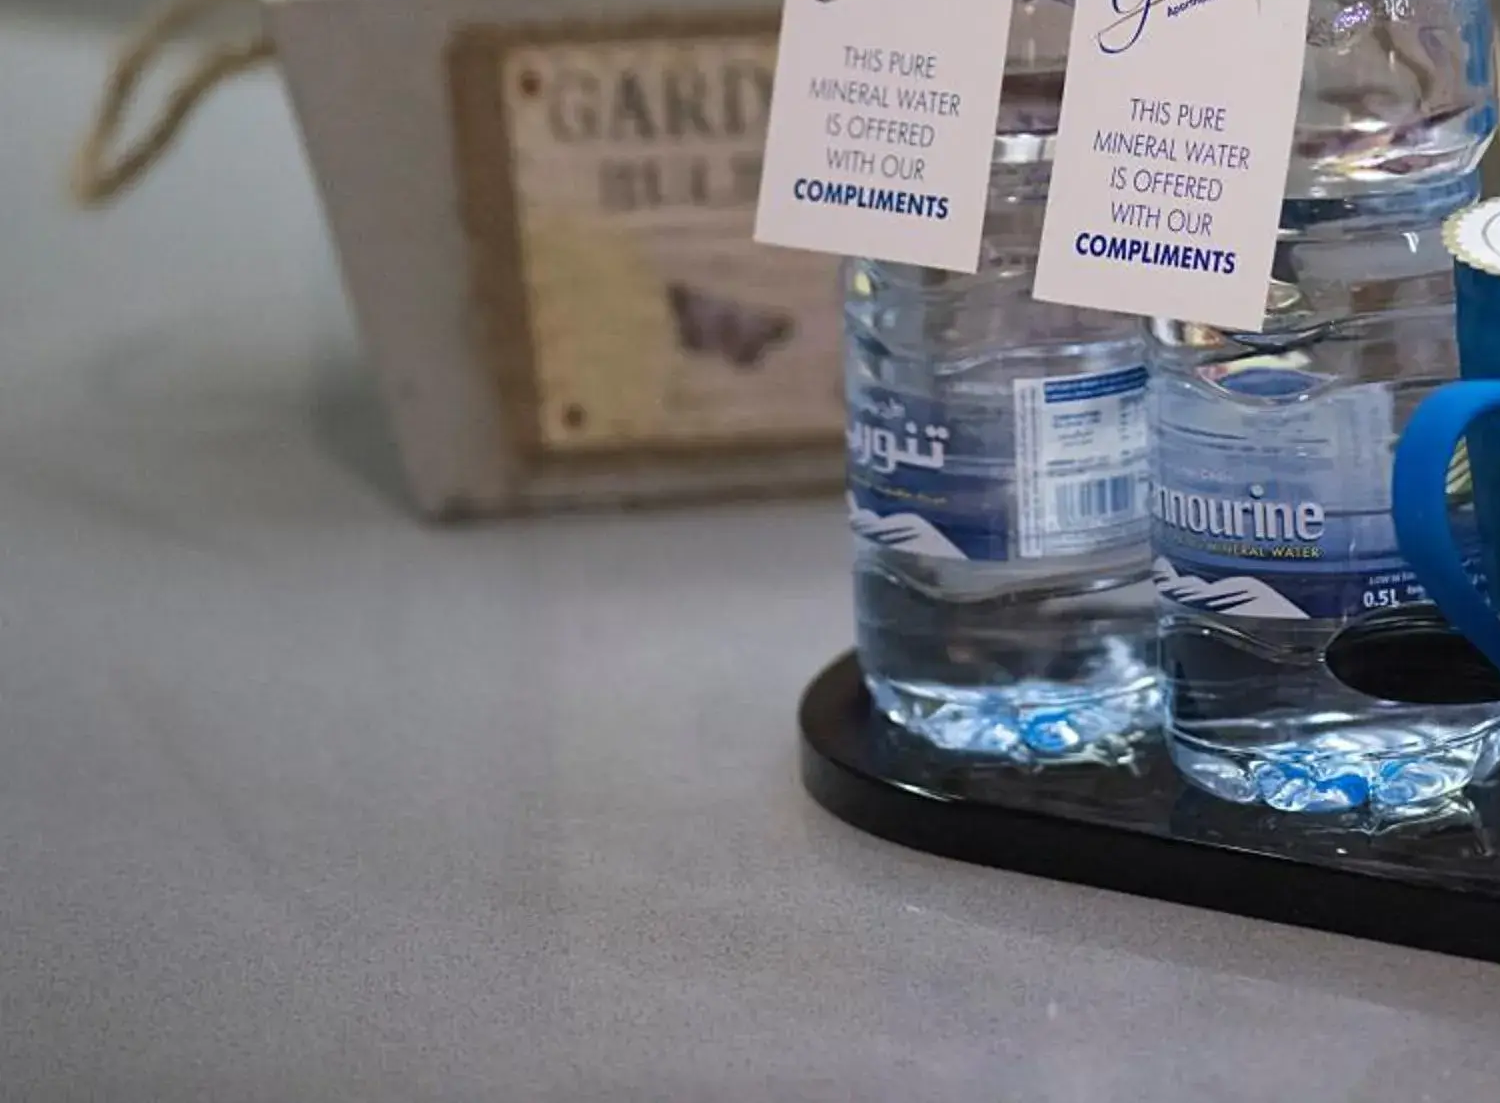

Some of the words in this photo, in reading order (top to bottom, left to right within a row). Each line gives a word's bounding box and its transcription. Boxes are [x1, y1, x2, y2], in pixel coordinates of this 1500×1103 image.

[843, 46, 884, 73] THIS
[889, 51, 937, 79] PURE
[808, 78, 890, 109] MINERAL
[897, 88, 961, 117] WATER
[1130, 98, 1171, 126] THIS
[1177, 104, 1227, 132] PURE
[826, 113, 843, 137] IS
[847, 115, 936, 148] OFFERED
[826, 147, 876, 175] WITH
[881, 154, 926, 182] OUR
[1093, 130, 1178, 162] MINERAL
[1185, 141, 1250, 170] WATER
[793, 178, 950, 220] COMPLIMENTS
[1110, 167, 1128, 191] IS
[1133, 169, 1224, 202] OFFERED
[1111, 201, 1161, 229] WITH
[1167, 208, 1213, 236] OUR
[1075, 232, 1237, 275] COMPLIMENTS
[1270, 546, 1322, 559] WATER
